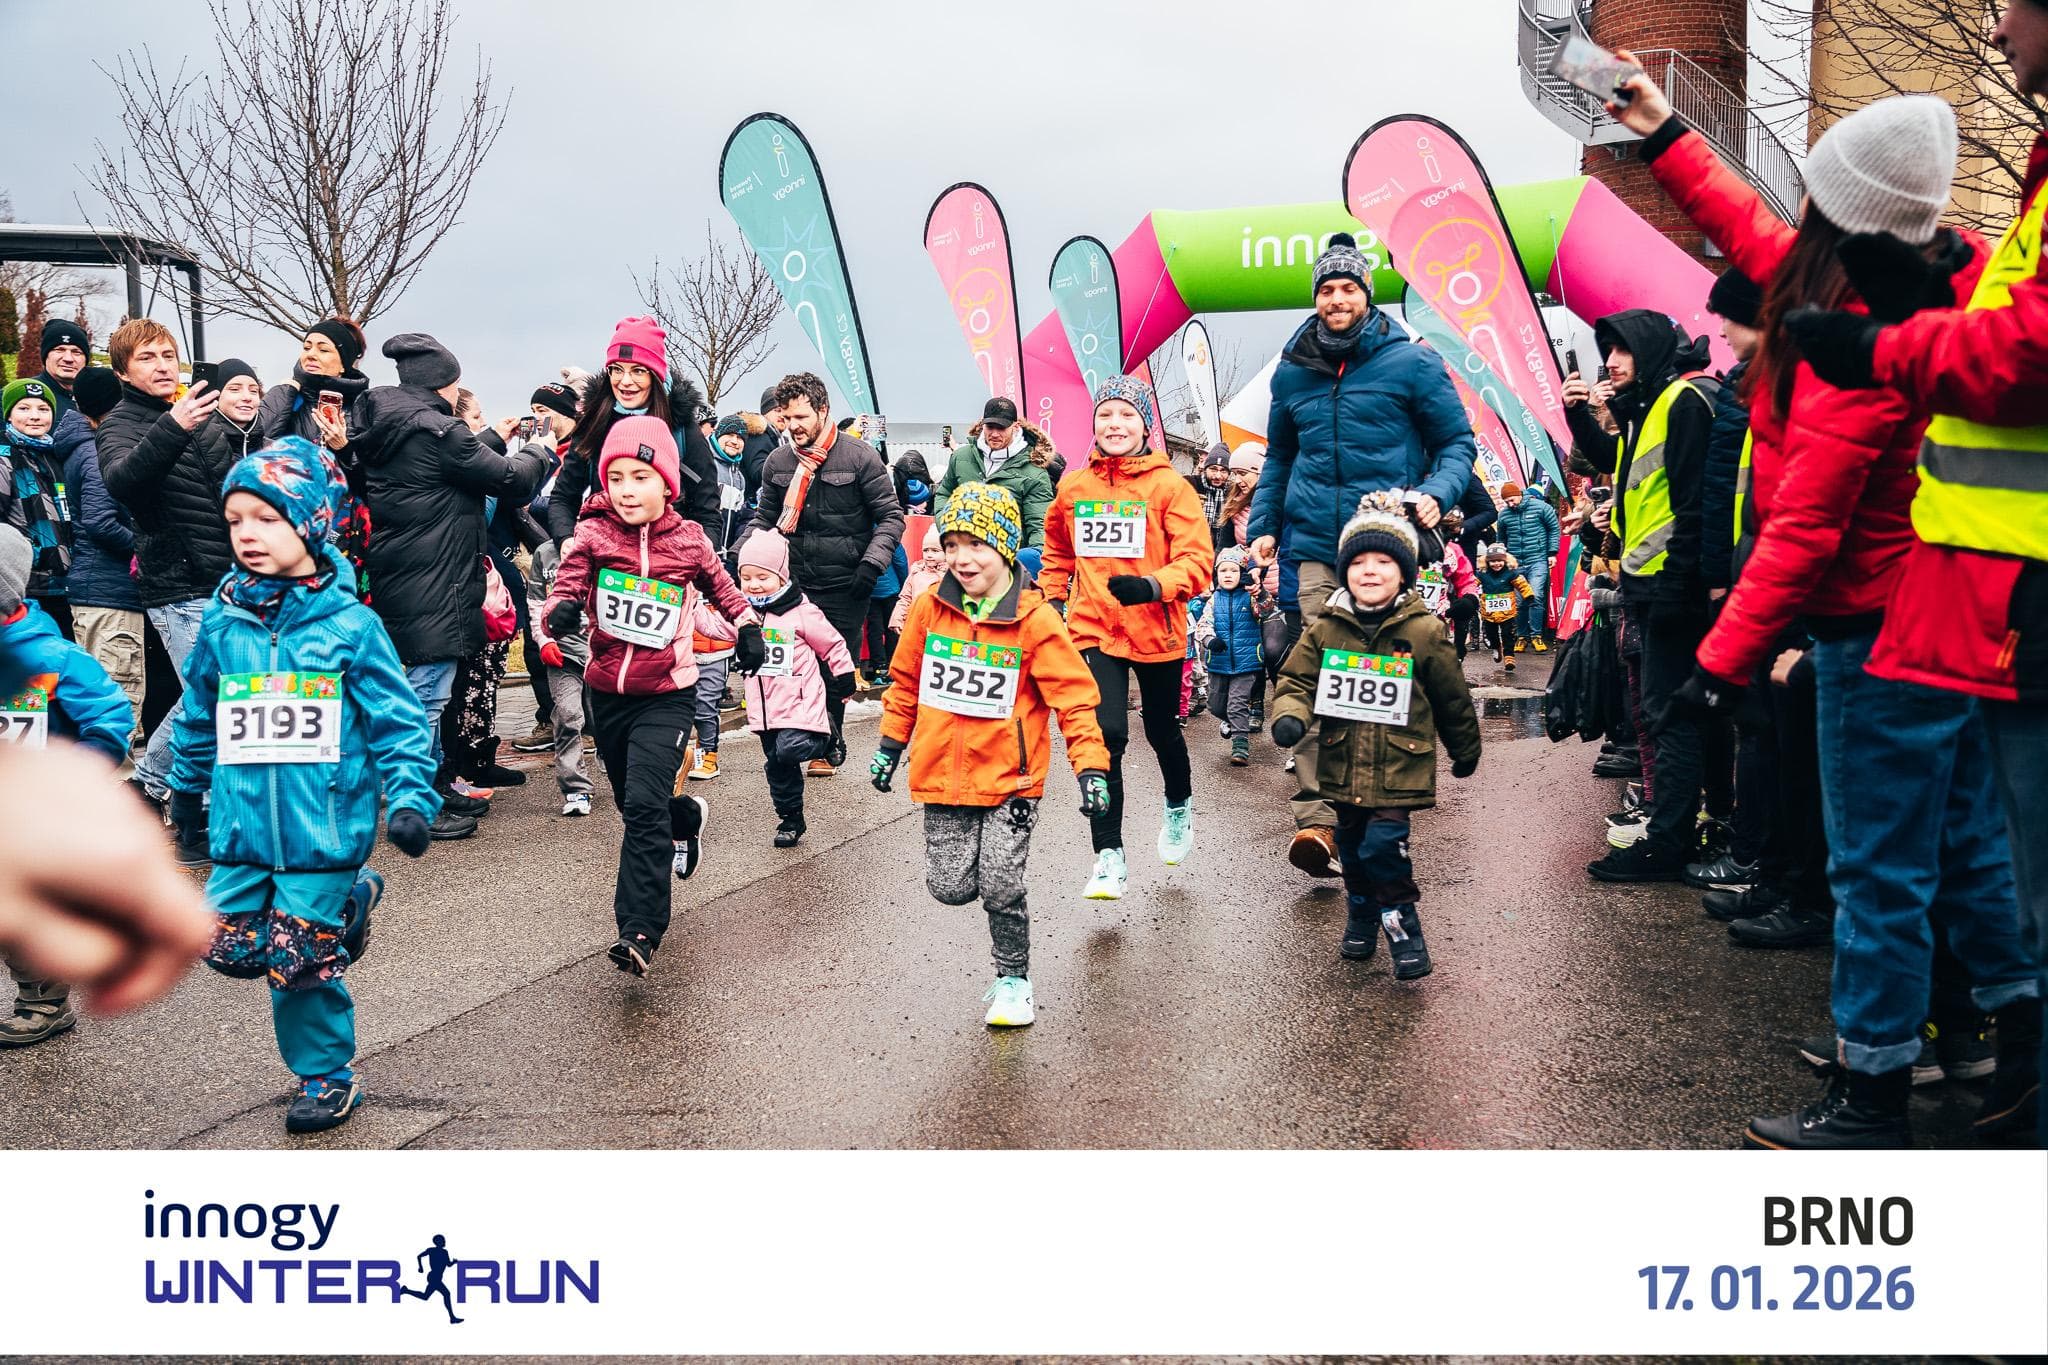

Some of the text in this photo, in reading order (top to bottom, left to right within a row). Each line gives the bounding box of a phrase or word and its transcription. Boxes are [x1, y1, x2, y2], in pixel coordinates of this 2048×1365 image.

[1241, 226, 1392, 271] inng
[1082, 521, 1134, 543] 3251
[605, 594, 671, 631] 3167
[1489, 599, 1507, 608] 3261
[929, 661, 1006, 700] 3252
[1327, 674, 1398, 706] 3189
[230, 705, 322, 741] 3193
